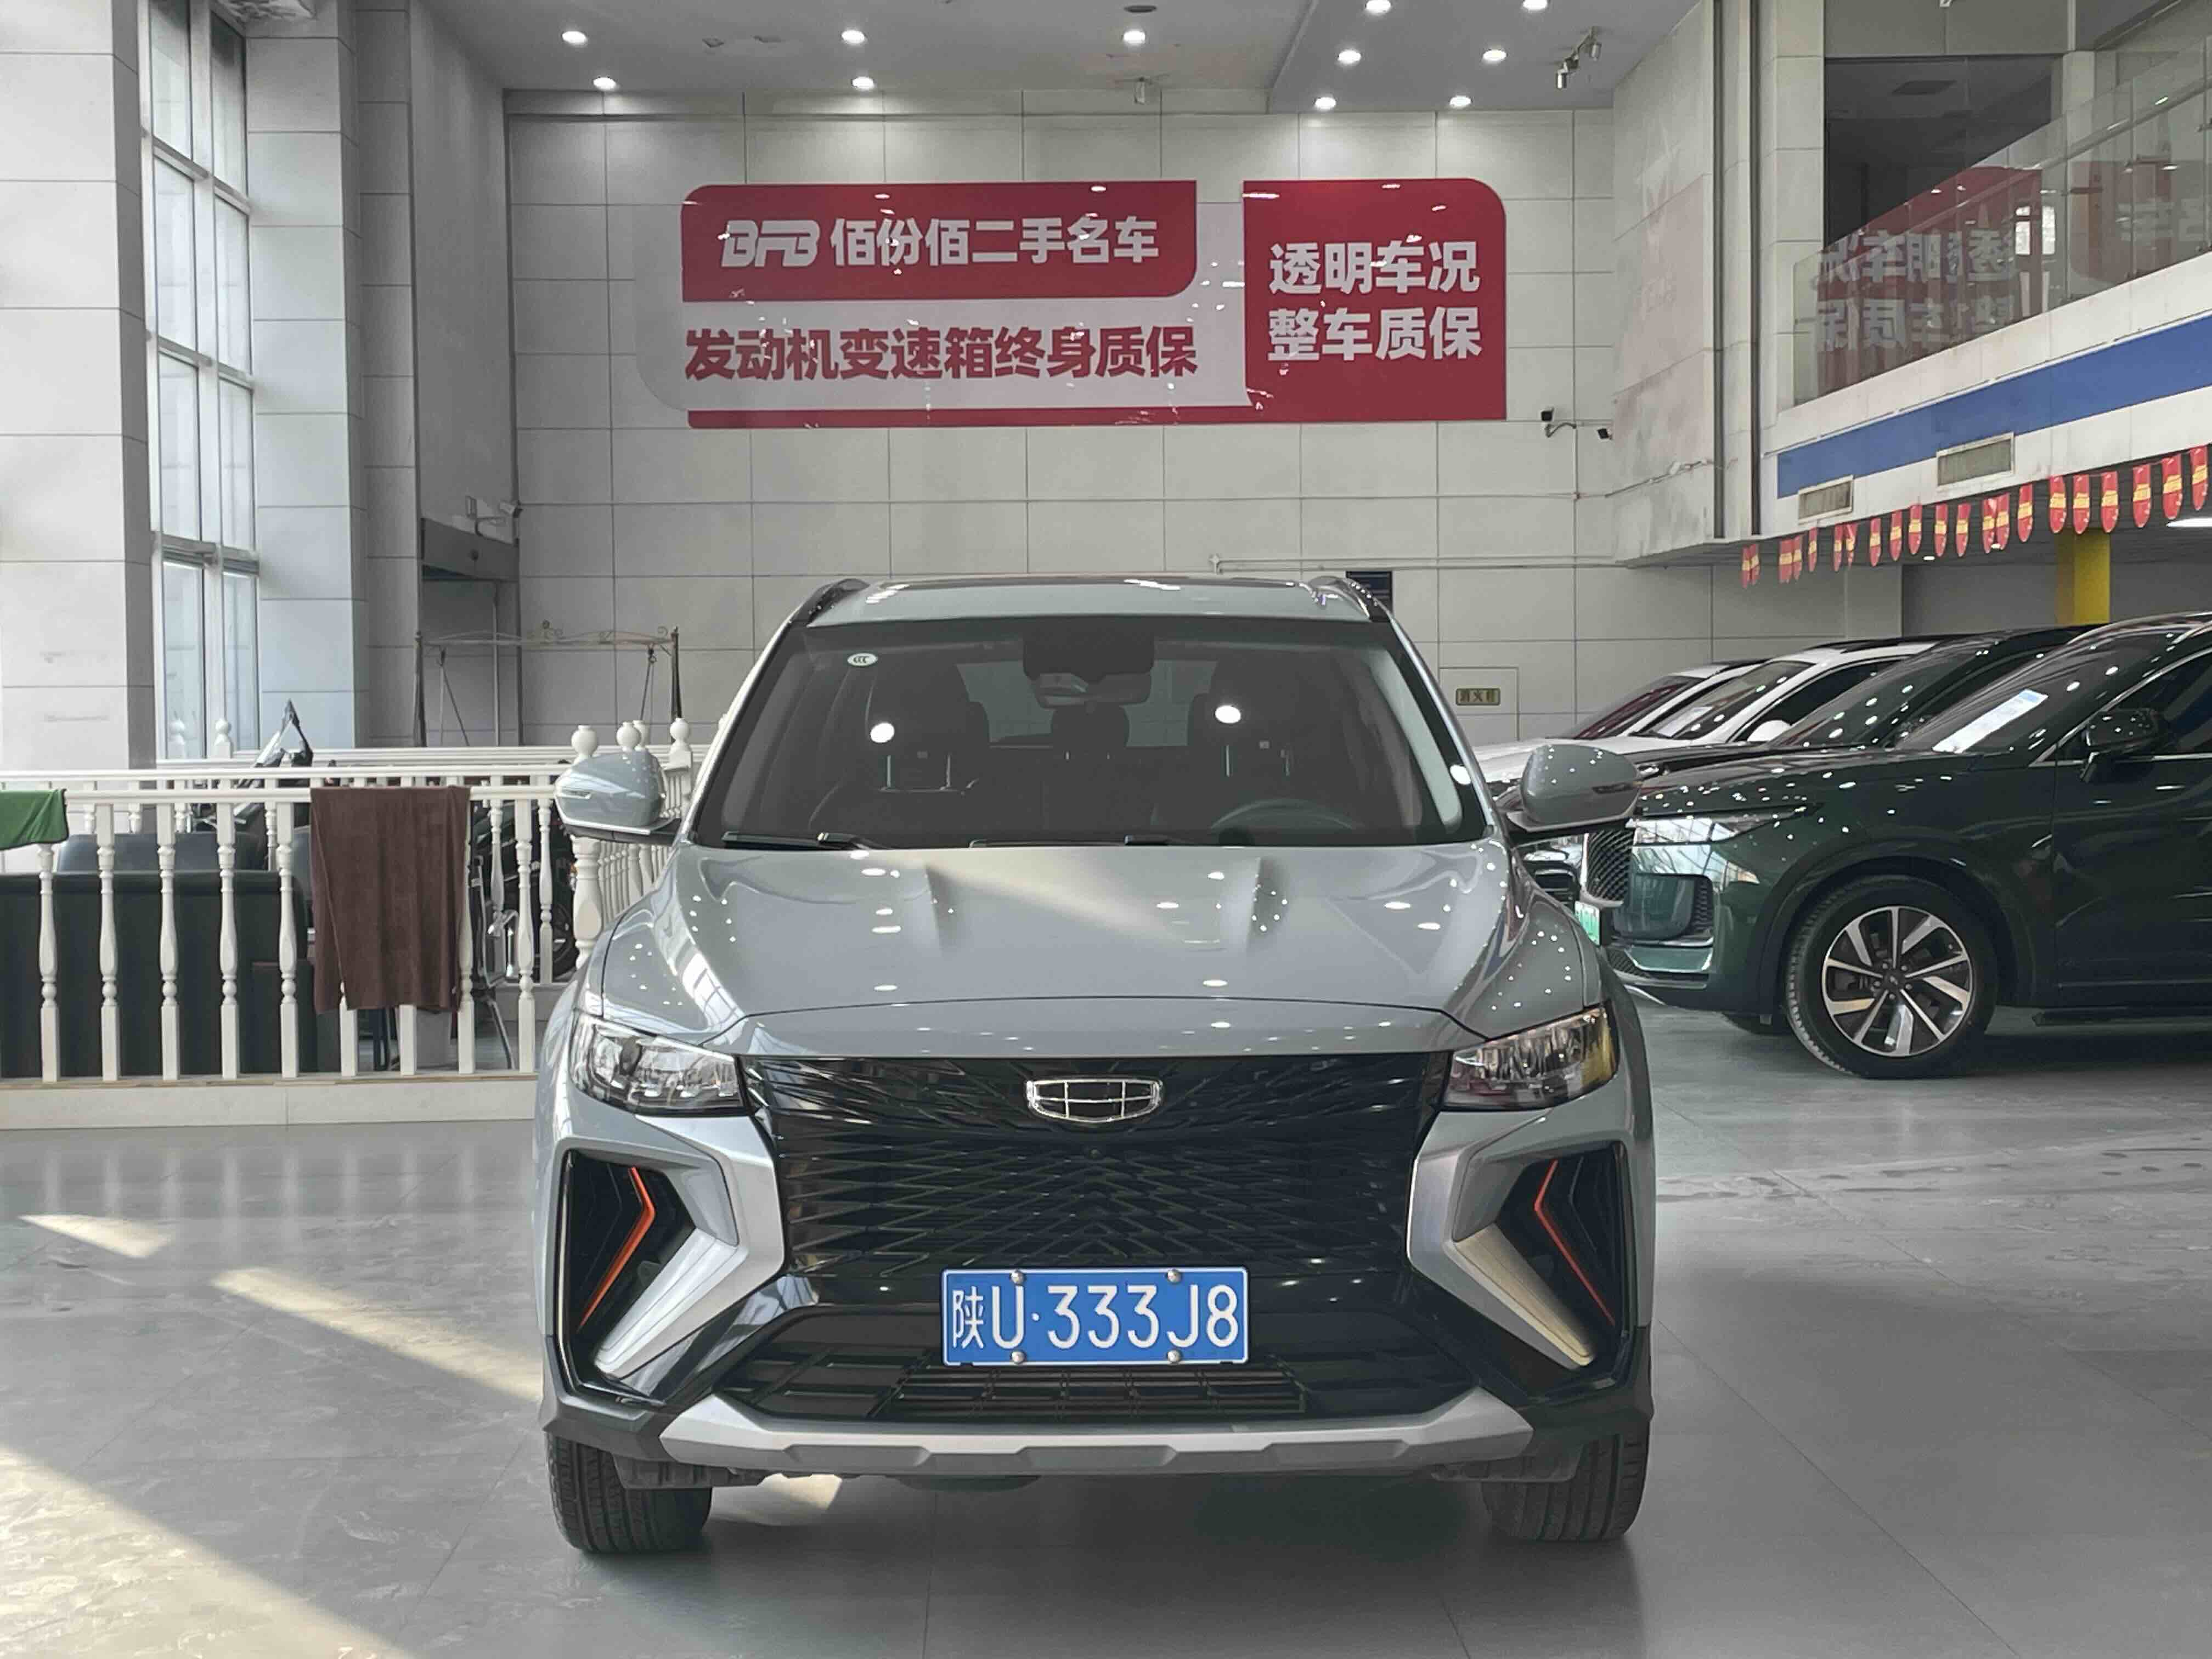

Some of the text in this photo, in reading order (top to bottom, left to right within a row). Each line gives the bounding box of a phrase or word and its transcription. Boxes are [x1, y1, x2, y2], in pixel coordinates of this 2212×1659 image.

[830, 215, 1159, 267] 佰份佰二手名车
[1269, 240, 1481, 295] 透明车况
[685, 325, 1198, 381] 发动机变速箱终身质保
[1268, 306, 1482, 362] 整车质保
[952, 1284, 1239, 1350] 陕U·333J8
